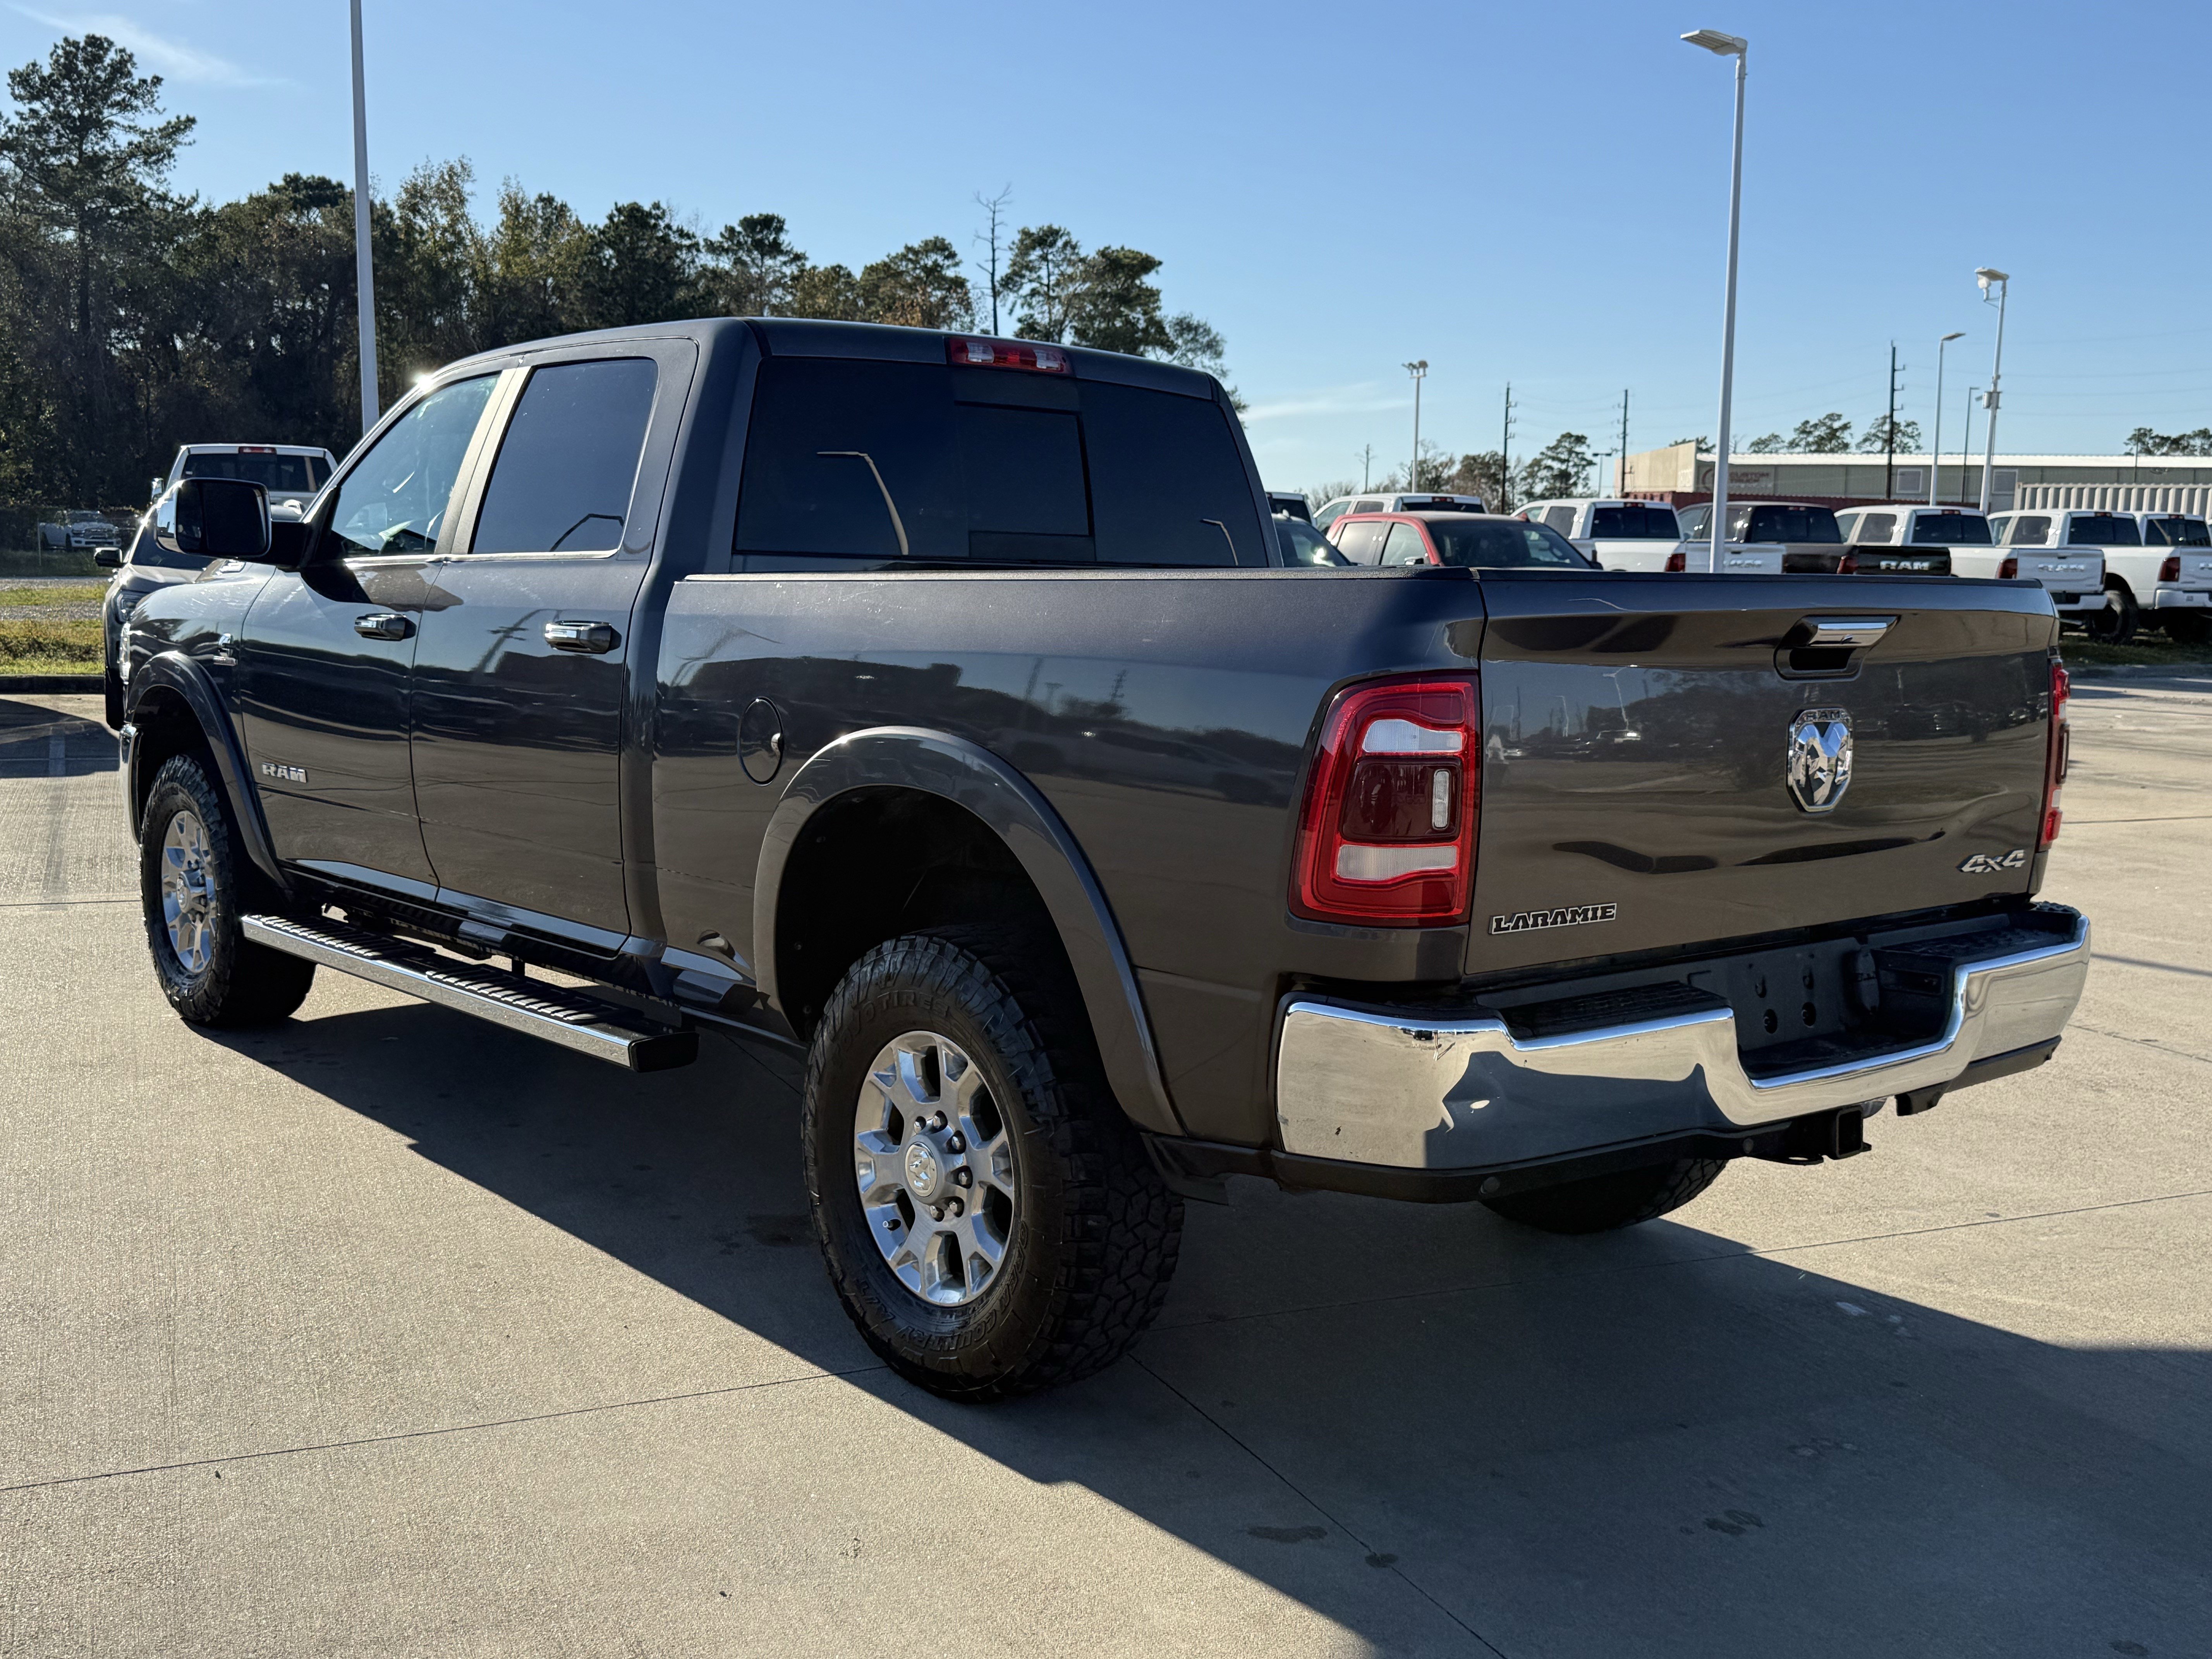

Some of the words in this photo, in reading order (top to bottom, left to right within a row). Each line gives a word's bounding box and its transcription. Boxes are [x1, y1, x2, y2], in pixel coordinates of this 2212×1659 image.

[1880, 560, 1930, 570] RAM
[1807, 709, 1842, 721] RAM
[262, 762, 307, 783] RAM
[1488, 903, 1617, 934] LARAMIE
[878, 990, 950, 1018] TIRES
[896, 1309, 996, 1351] COUNTRY
